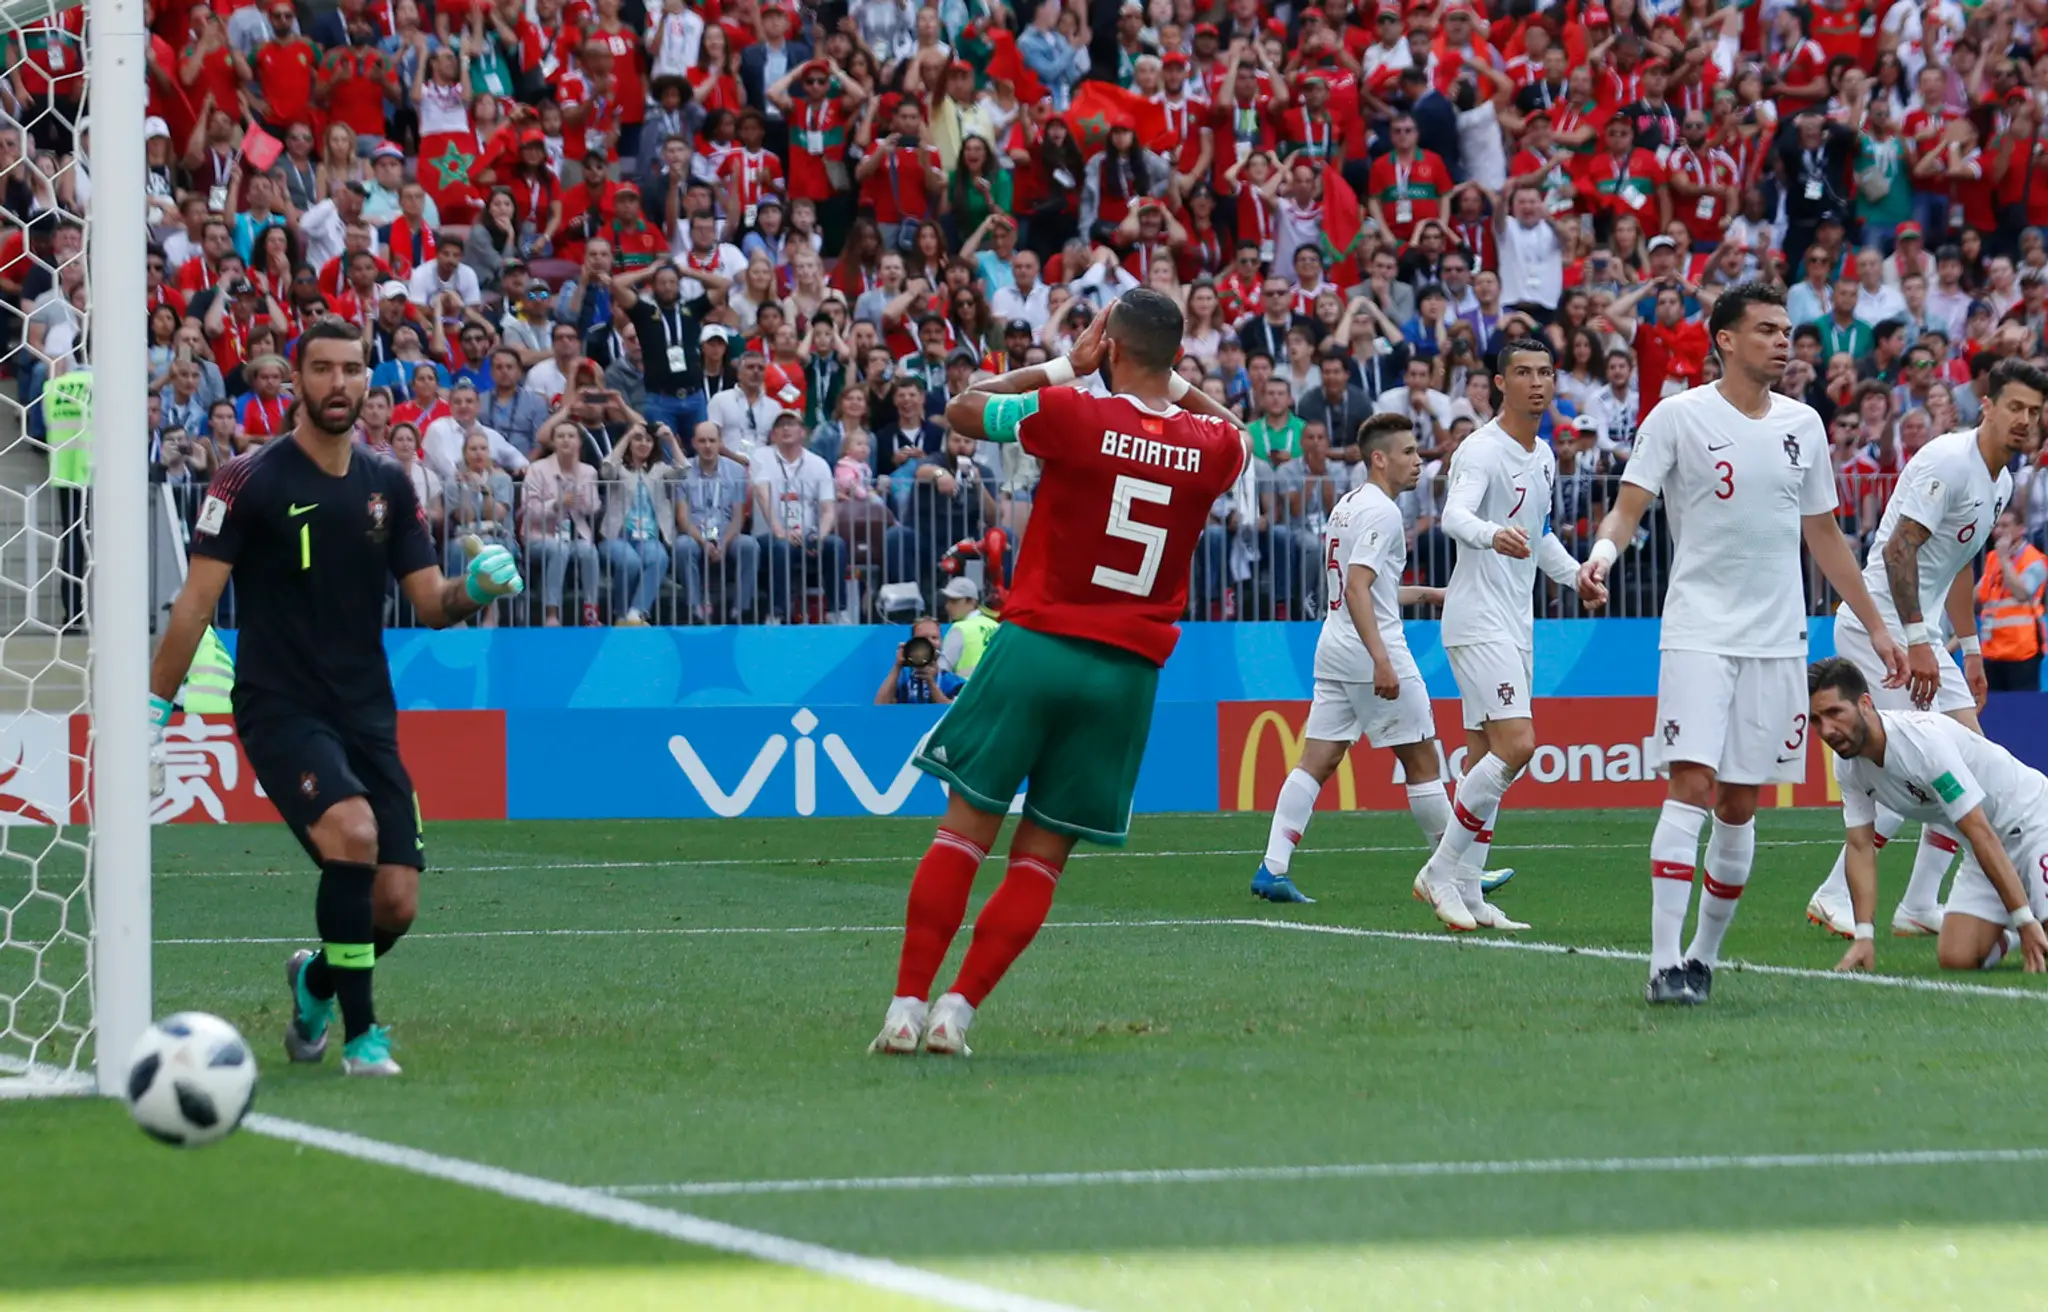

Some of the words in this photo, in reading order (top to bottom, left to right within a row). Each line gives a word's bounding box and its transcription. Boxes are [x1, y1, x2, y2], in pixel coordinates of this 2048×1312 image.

[1101, 430, 1201, 473] BENATIA
[1714, 460, 1735, 500] 3
[1508, 487, 1526, 518] 7
[300, 522, 311, 569] 1
[1090, 474, 1173, 597] 5
[1957, 517, 1979, 544] 6
[1784, 713, 1807, 751] 3
[150, 713, 268, 824] 蒙
[668, 707, 1028, 817] viv
